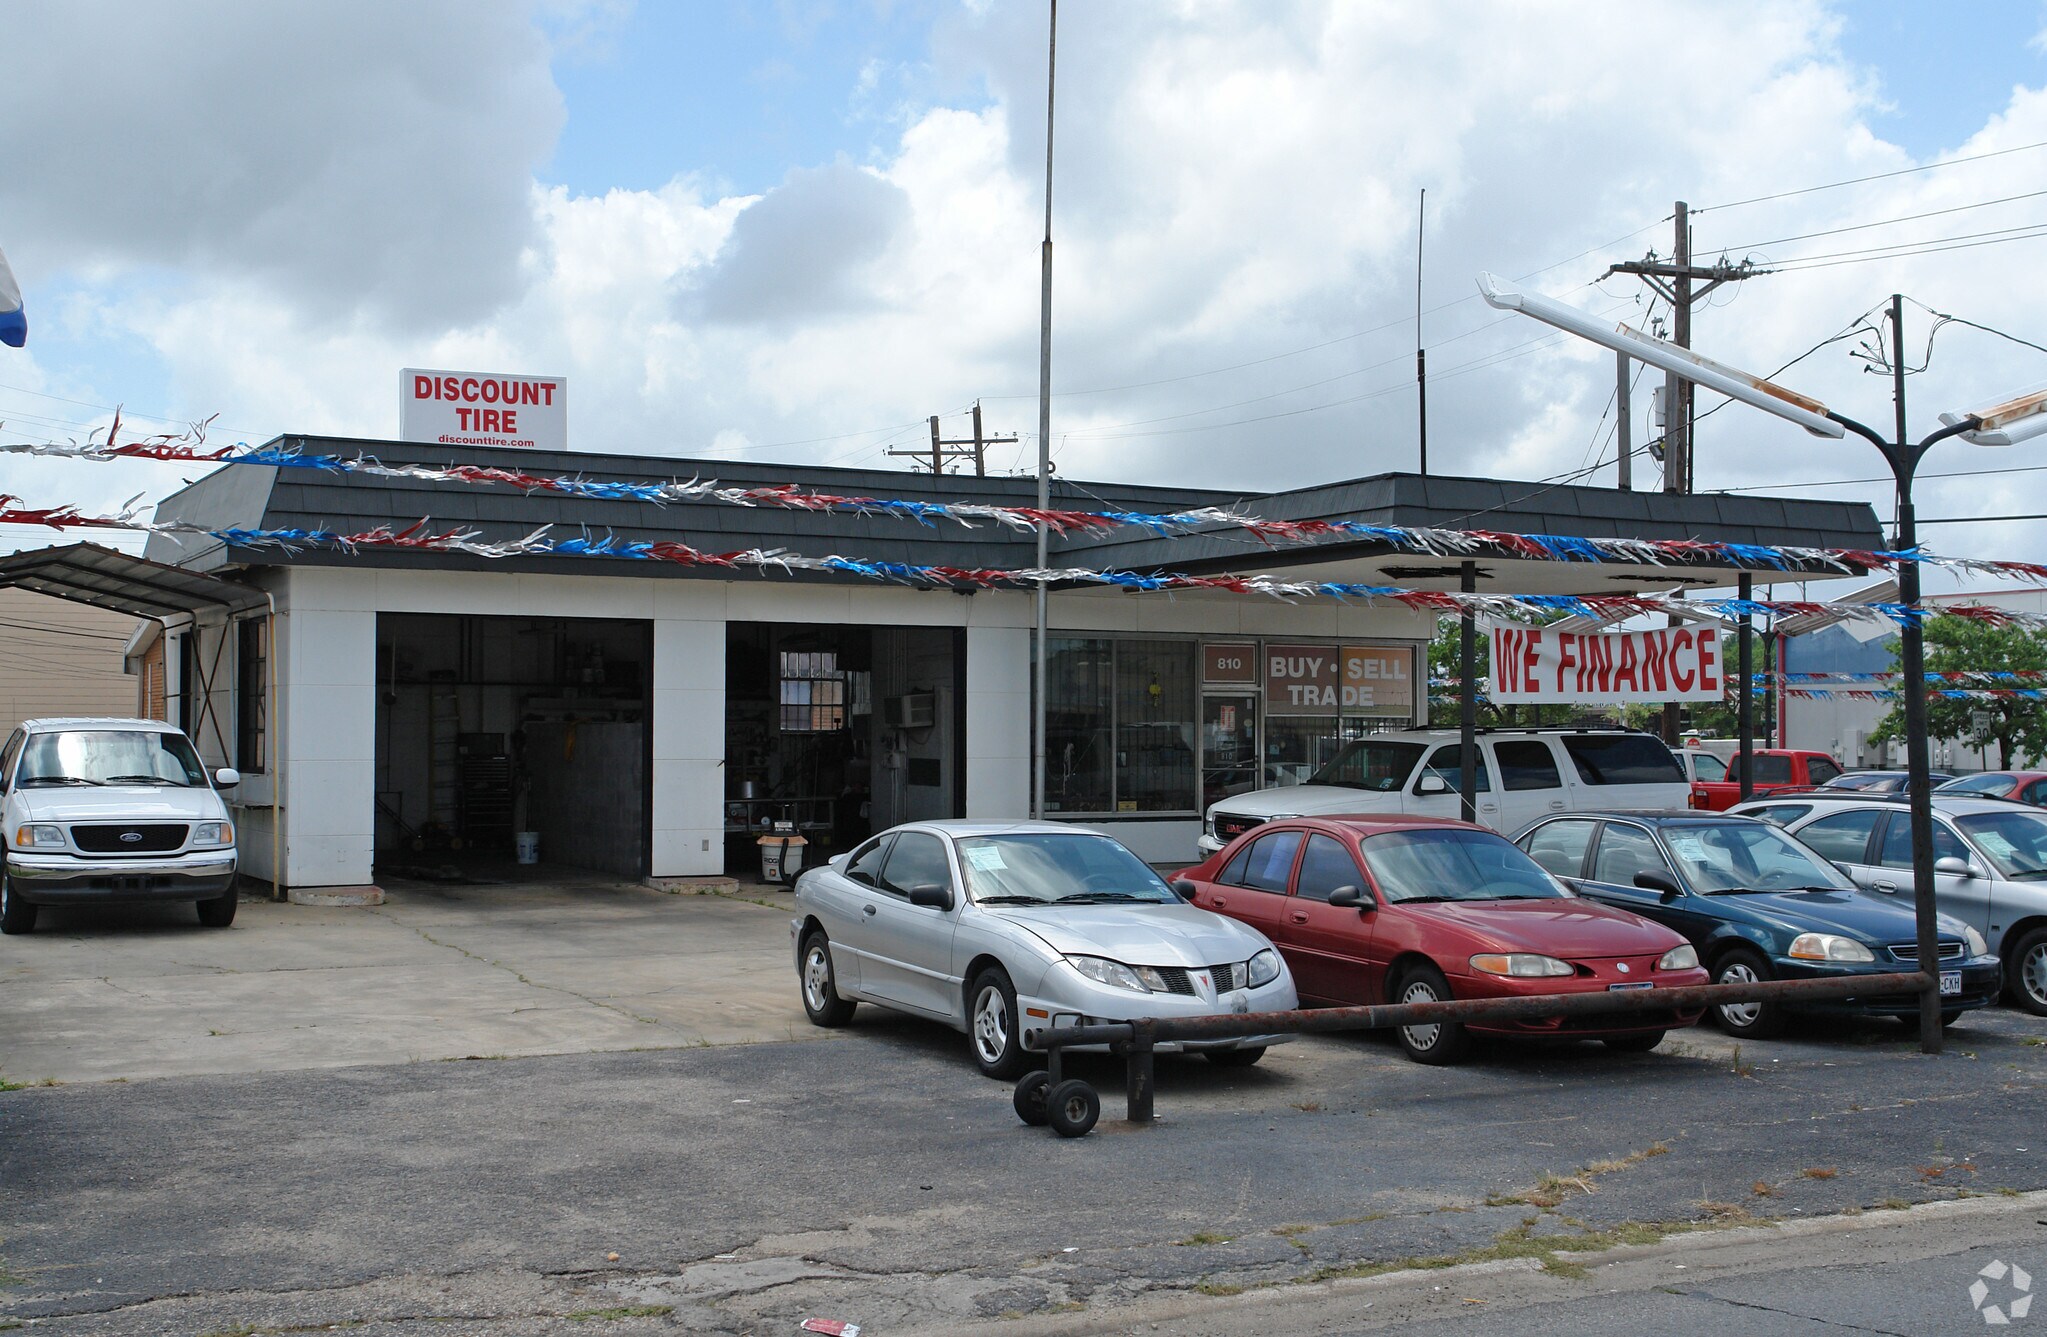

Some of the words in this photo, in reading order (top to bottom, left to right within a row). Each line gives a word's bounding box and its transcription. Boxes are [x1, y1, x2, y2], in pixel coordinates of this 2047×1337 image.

[414, 375, 556, 406] DISCOUNT
[455, 407, 517, 434] TIRE
[438, 434, 535, 447] discounttire.com
[1217, 657, 1242, 670] 810
[1270, 656, 1324, 678] BUY
[1347, 658, 1407, 680] SELL
[1495, 628, 1542, 693] WE
[1557, 628, 1718, 693] FINANCE
[1287, 685, 1374, 706] TRADE
[1976, 727, 1989, 739] 30
[1226, 824, 1246, 833] GMC
